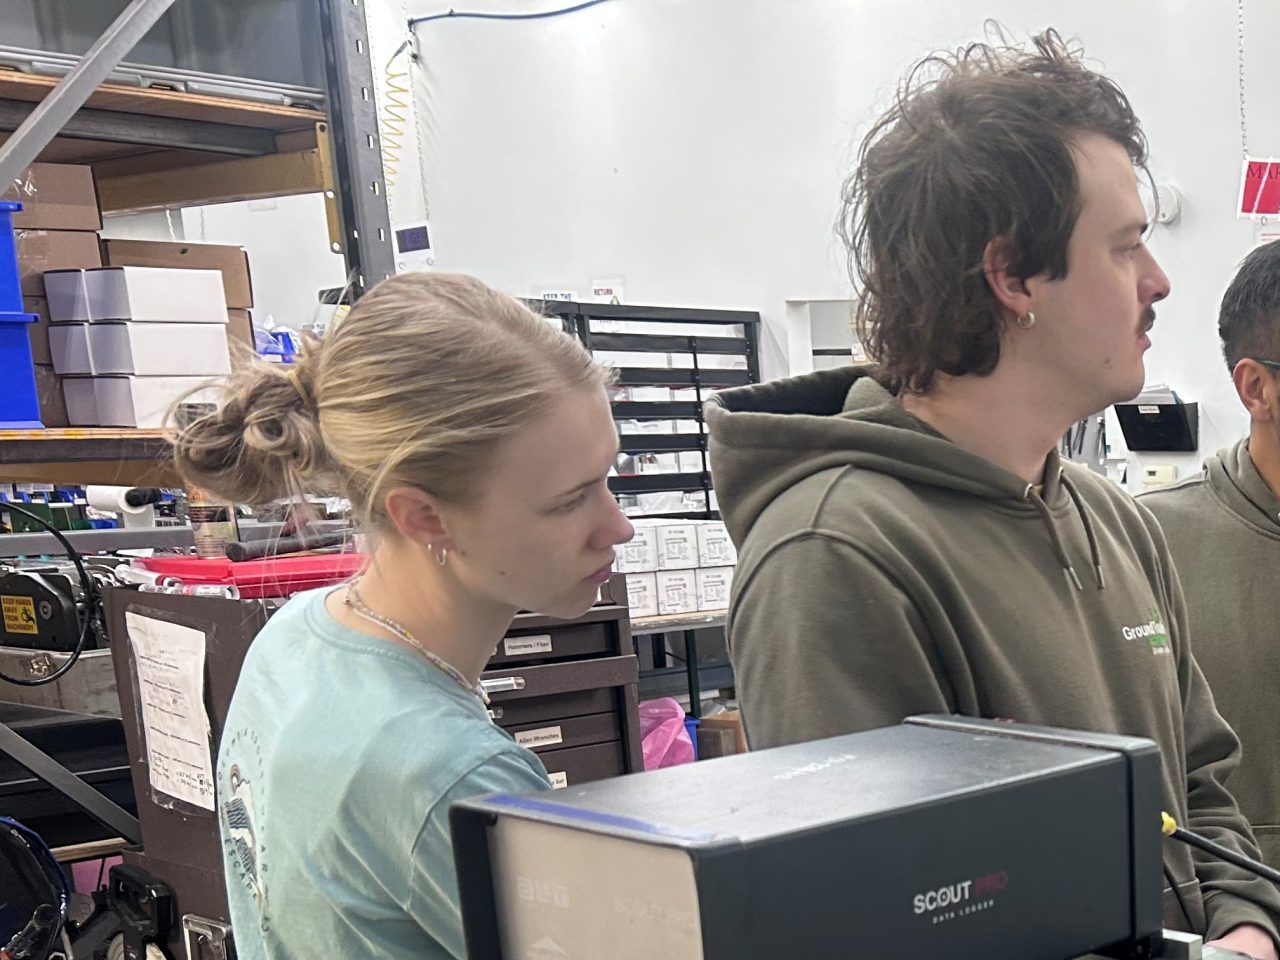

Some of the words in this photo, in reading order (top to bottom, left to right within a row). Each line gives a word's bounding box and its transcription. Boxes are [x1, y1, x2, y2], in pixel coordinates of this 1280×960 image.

[913, 879, 973, 915] SCOUT
[932, 911, 956, 925] DATA
[959, 898, 995, 916] LOGGER
